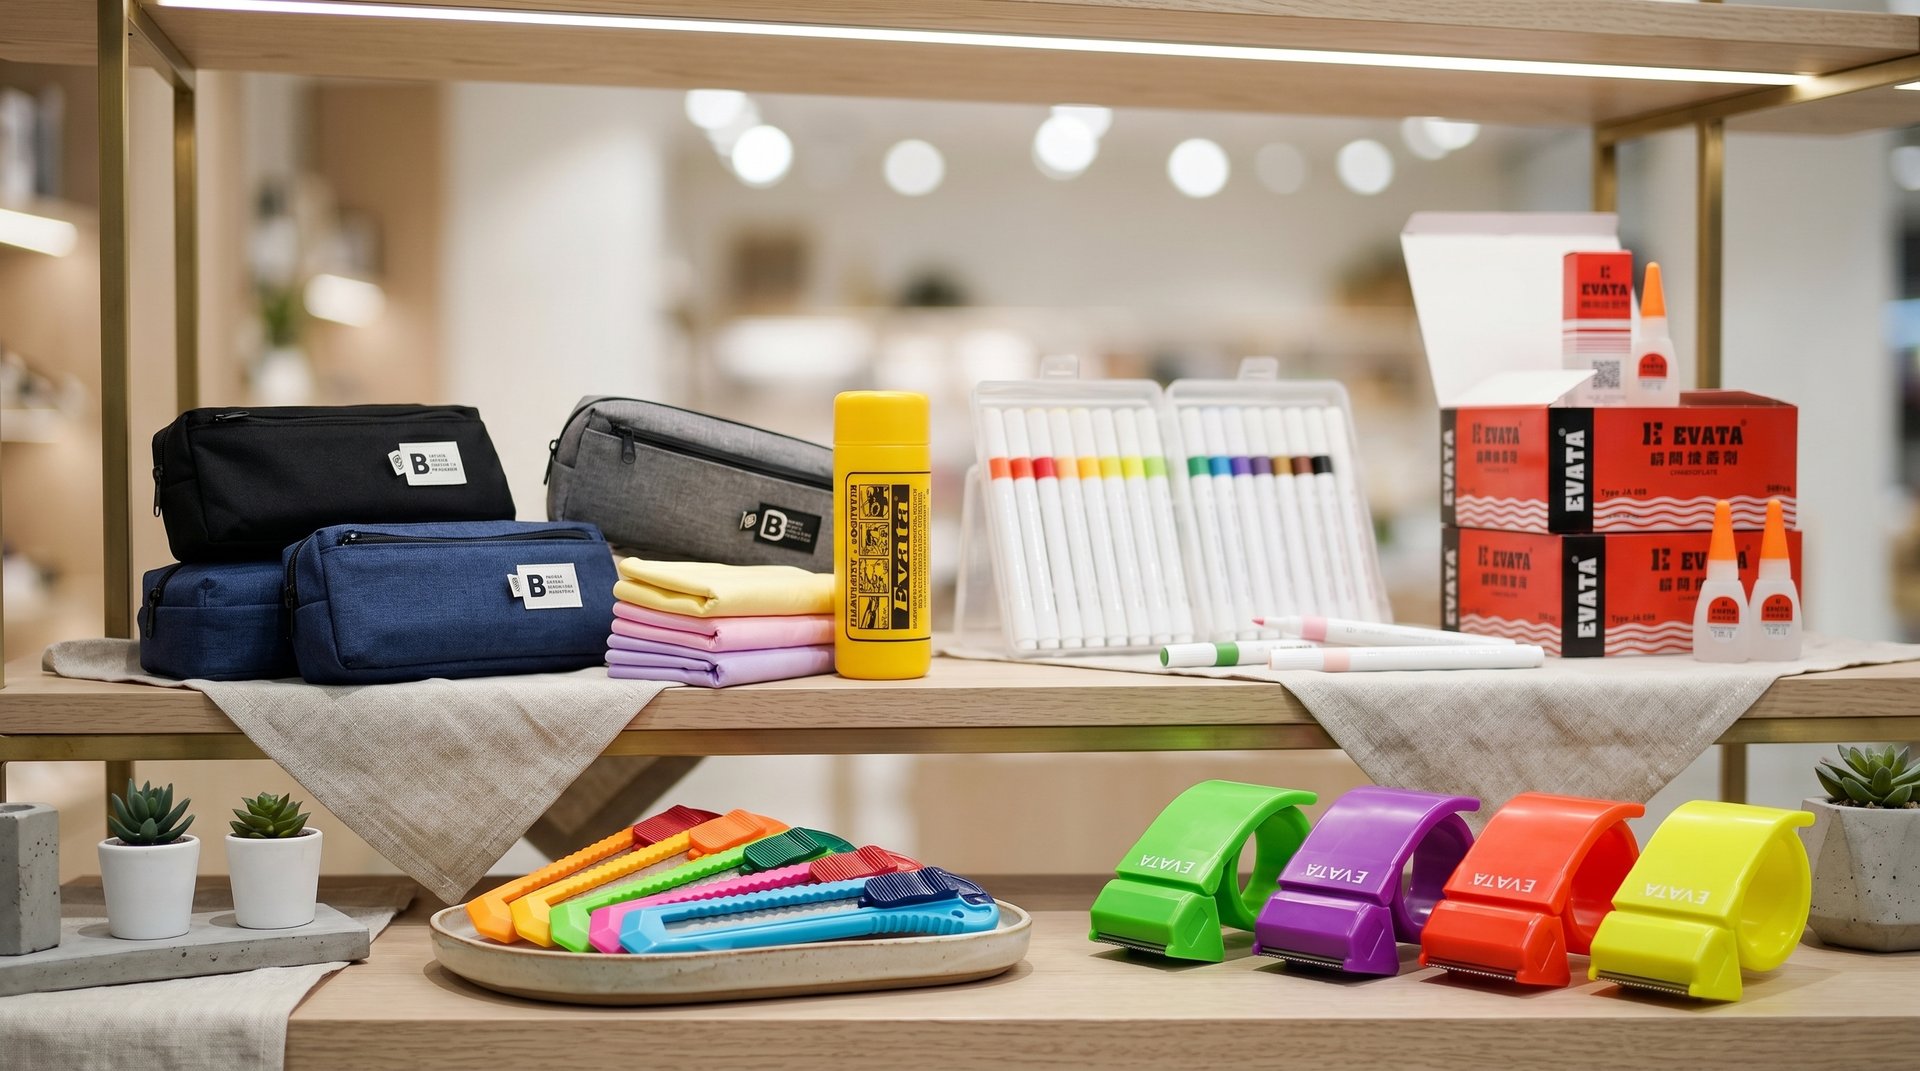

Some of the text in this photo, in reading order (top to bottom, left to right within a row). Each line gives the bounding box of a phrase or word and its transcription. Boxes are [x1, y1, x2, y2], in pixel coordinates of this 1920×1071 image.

[1581, 283, 1628, 296] EVATA
[1484, 426, 1520, 445] EVATA
[1673, 425, 1743, 445] EVATA
[409, 453, 430, 475] B
[1443, 429, 1454, 507] EVATA
[1565, 429, 1585, 512] EVATA
[762, 512, 785, 539] B
[893, 500, 909, 612] Evata
[1492, 550, 1531, 570] EVATA
[1681, 551, 1748, 571] EVA
[526, 574, 547, 598] B
[1445, 549, 1457, 626] EVATA
[1577, 557, 1597, 638] EVATA
[1139, 853, 1196, 874] EVATA
[1306, 863, 1369, 884] EVATA
[1473, 872, 1537, 893] EVATA
[1644, 882, 1711, 905] EVATA
